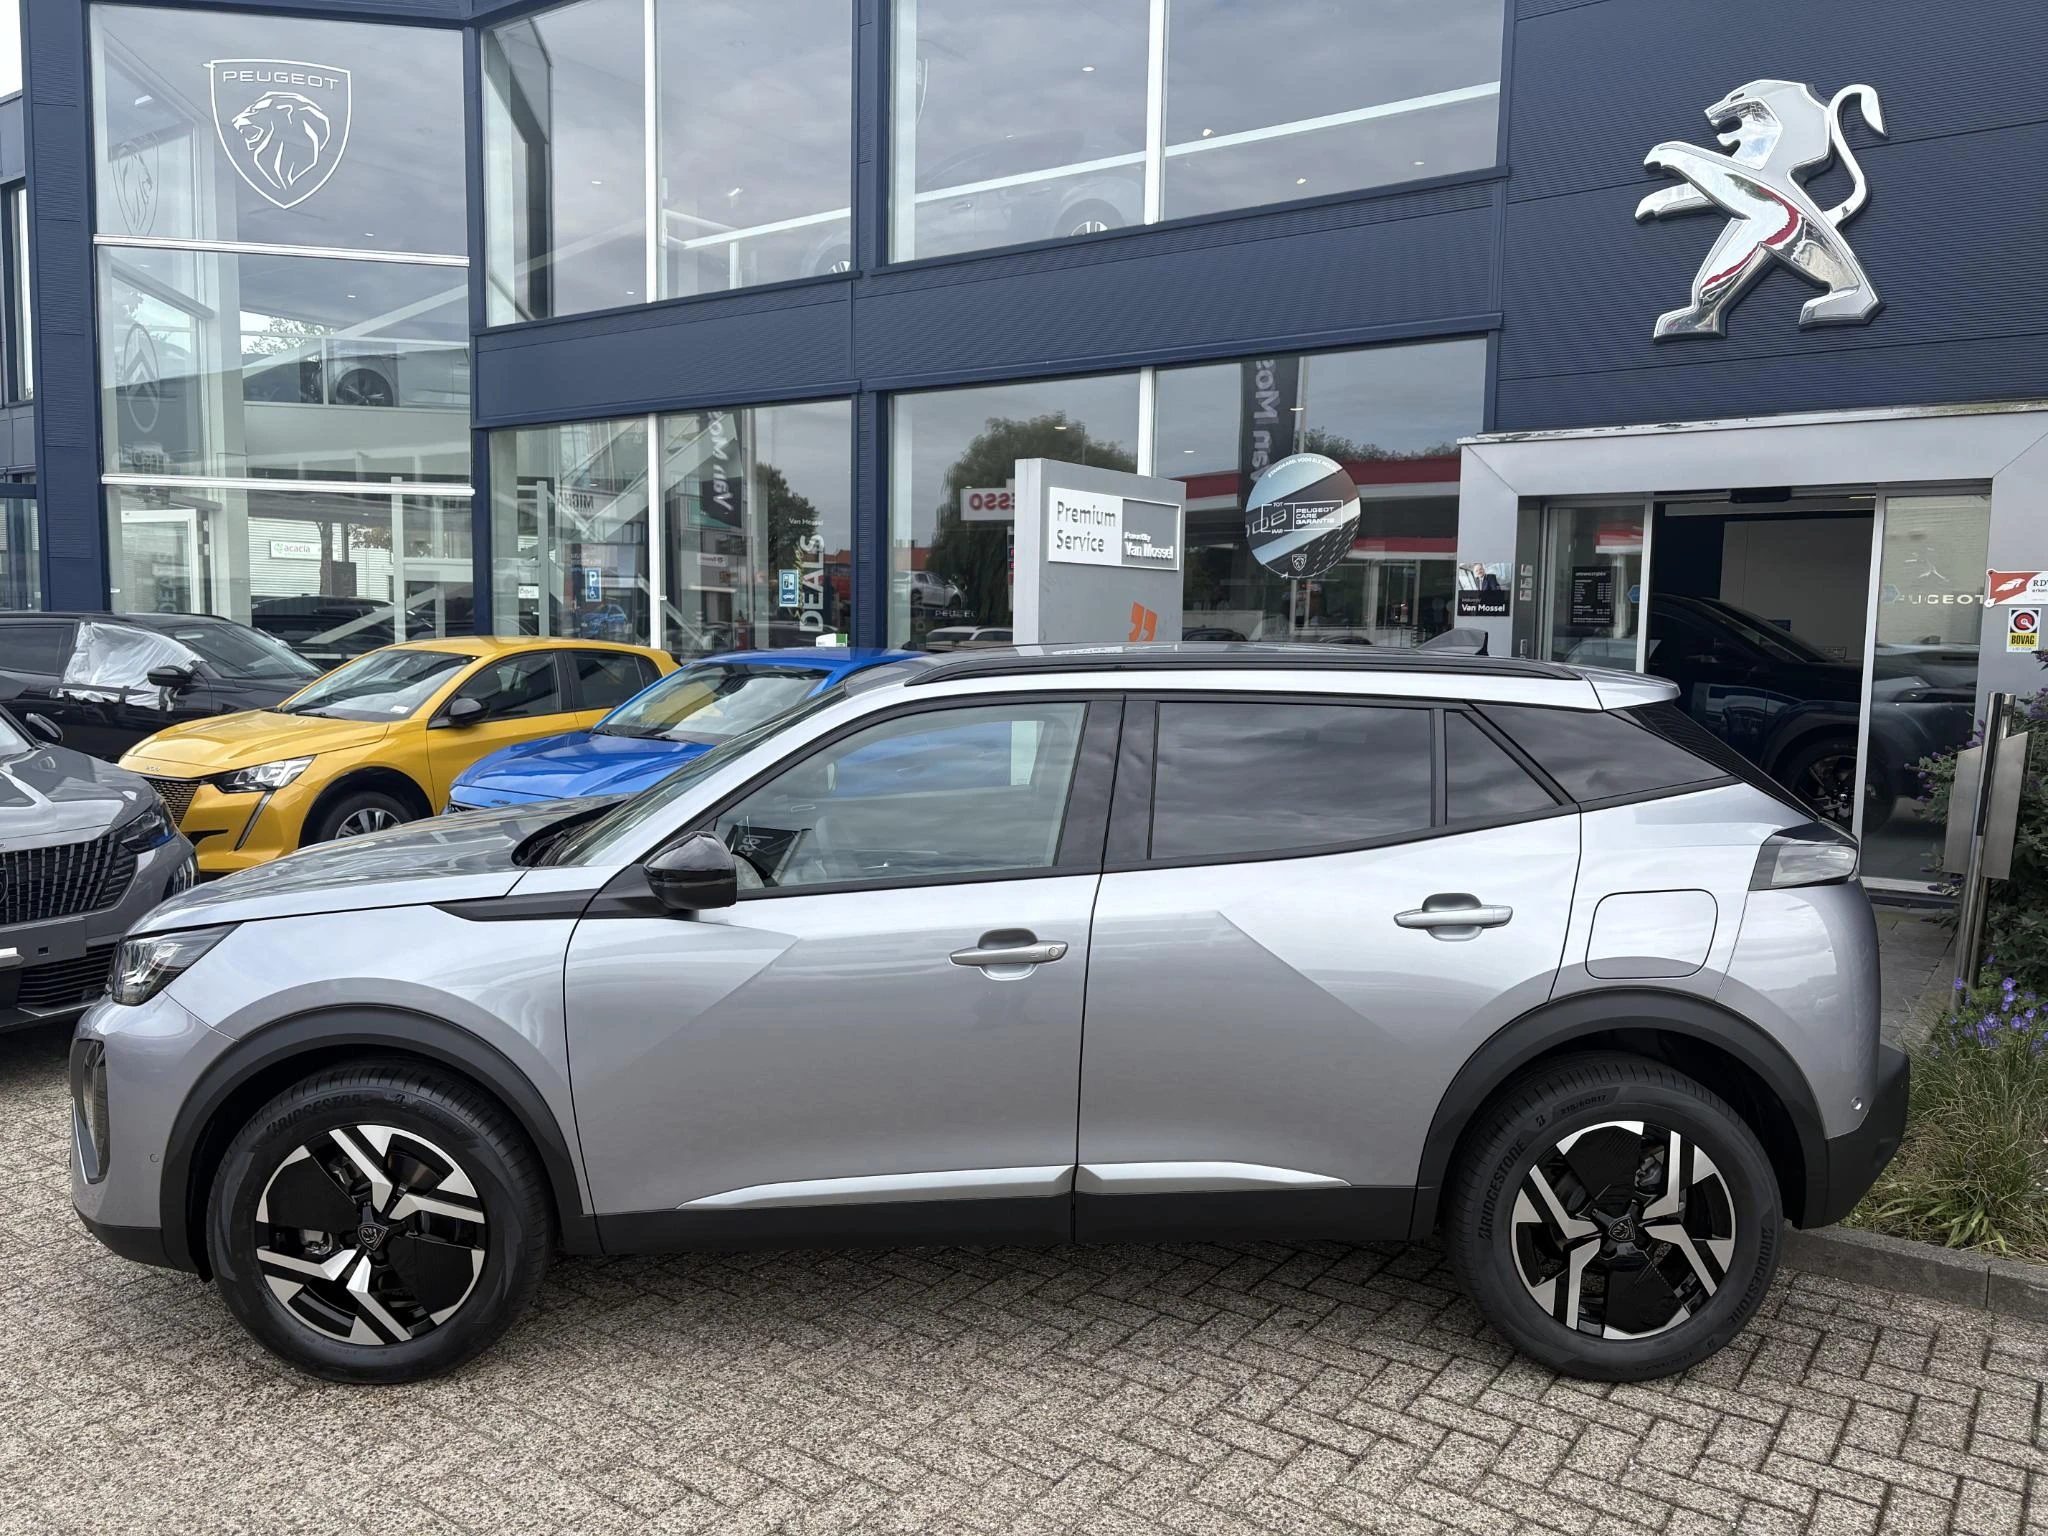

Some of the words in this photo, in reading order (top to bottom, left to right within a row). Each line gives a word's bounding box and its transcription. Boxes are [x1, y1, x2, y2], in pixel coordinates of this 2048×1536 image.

[223, 71, 339, 90] PEUGEOT
[1057, 501, 1116, 527] Premium
[1296, 506, 1335, 514] PEUGEOT
[1056, 529, 1105, 552] Service
[1124, 541, 1142, 557] Van
[1143, 543, 1174, 559] Mossel
[800, 534, 824, 632] DEALS
[2032, 579, 2048, 587] RD
[1461, 603, 1477, 612] Van
[1478, 603, 1506, 612] Mossel
[1898, 594, 1985, 605] EUGEOT
[2011, 635, 2035, 645] BOVAG
[1478, 1139, 1526, 1241] BRIDGESTONE
